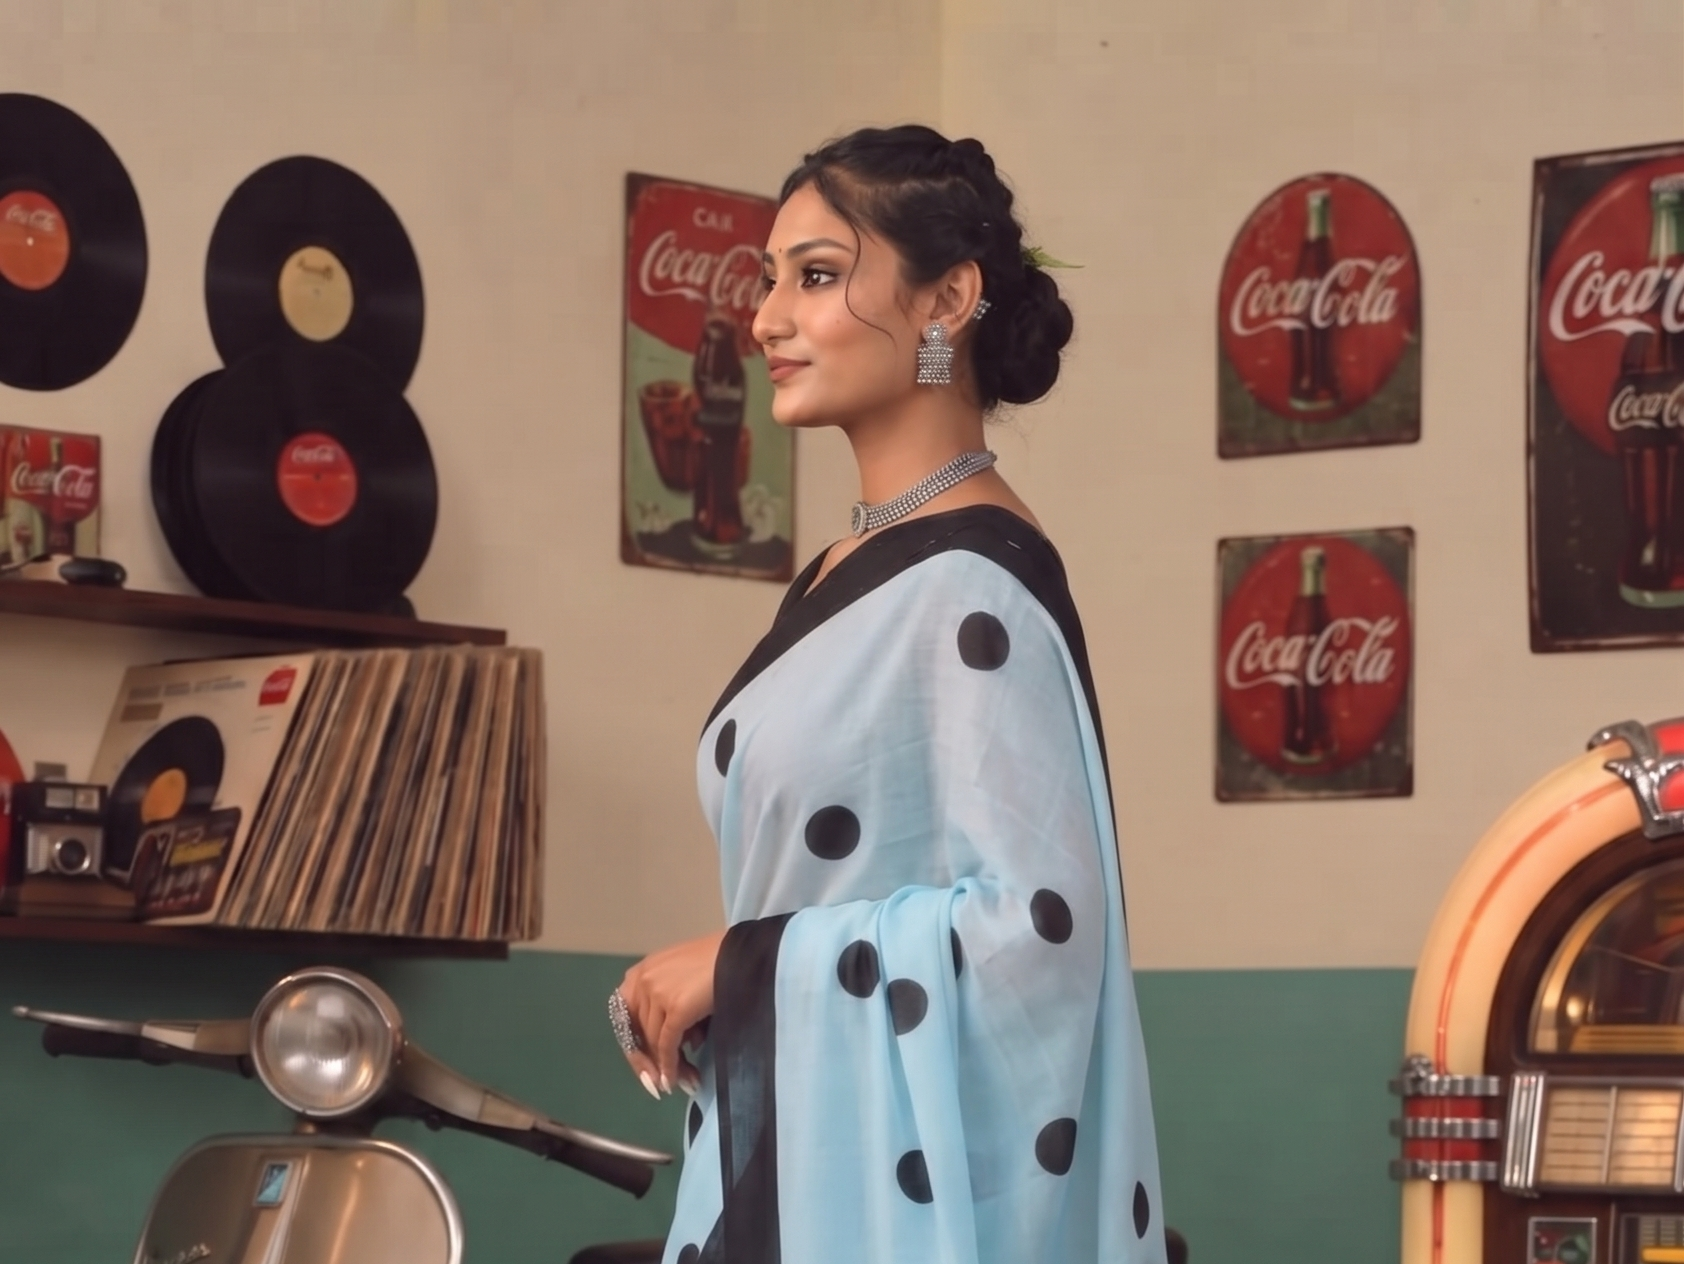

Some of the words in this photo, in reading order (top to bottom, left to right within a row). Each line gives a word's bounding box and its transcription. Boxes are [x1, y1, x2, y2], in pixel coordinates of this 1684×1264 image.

[639, 229, 767, 312] Coca-Col
[1229, 254, 1410, 337] Coca-Cola
[1548, 250, 1684, 342] Coca-C
[1608, 383, 1684, 432] Coca-C
[1225, 615, 1400, 691] Coca-Cola
